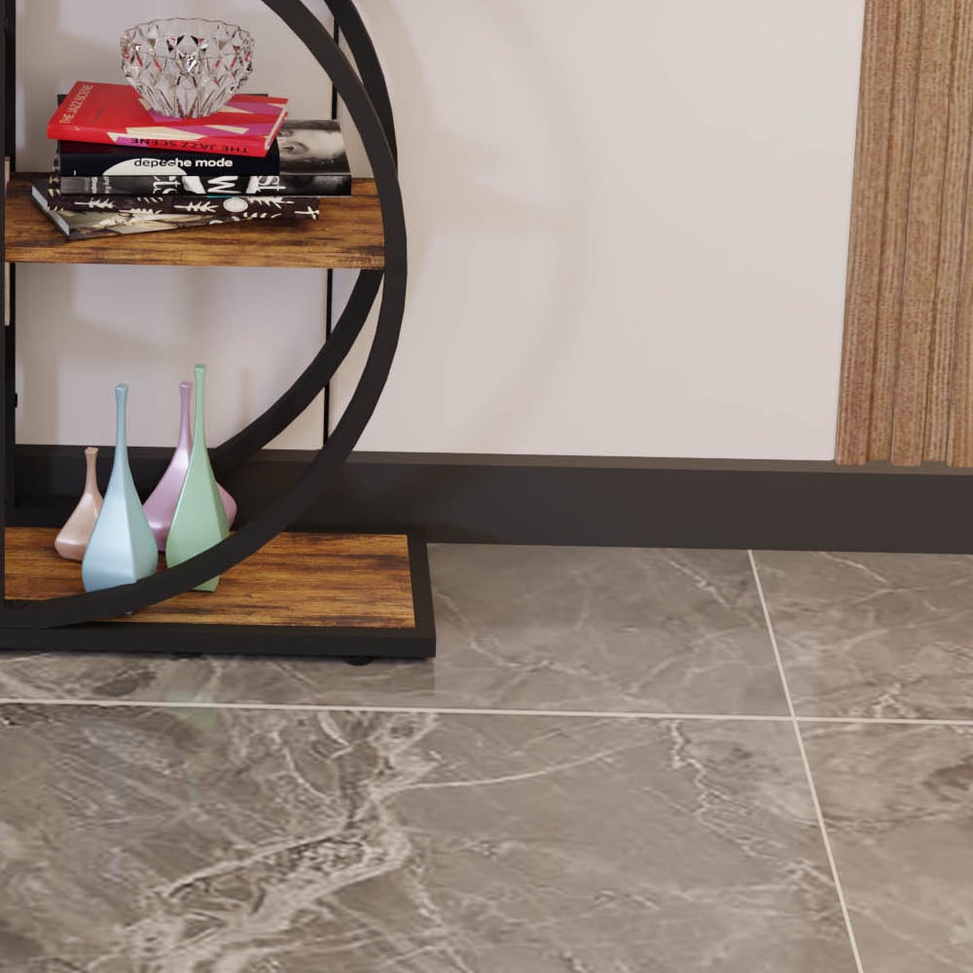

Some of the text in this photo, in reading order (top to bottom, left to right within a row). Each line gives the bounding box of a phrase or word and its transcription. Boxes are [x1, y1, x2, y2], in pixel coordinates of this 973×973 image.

[131, 138, 249, 154] THE JAZZ SCENE
[134, 157, 233, 168] depeche mode
